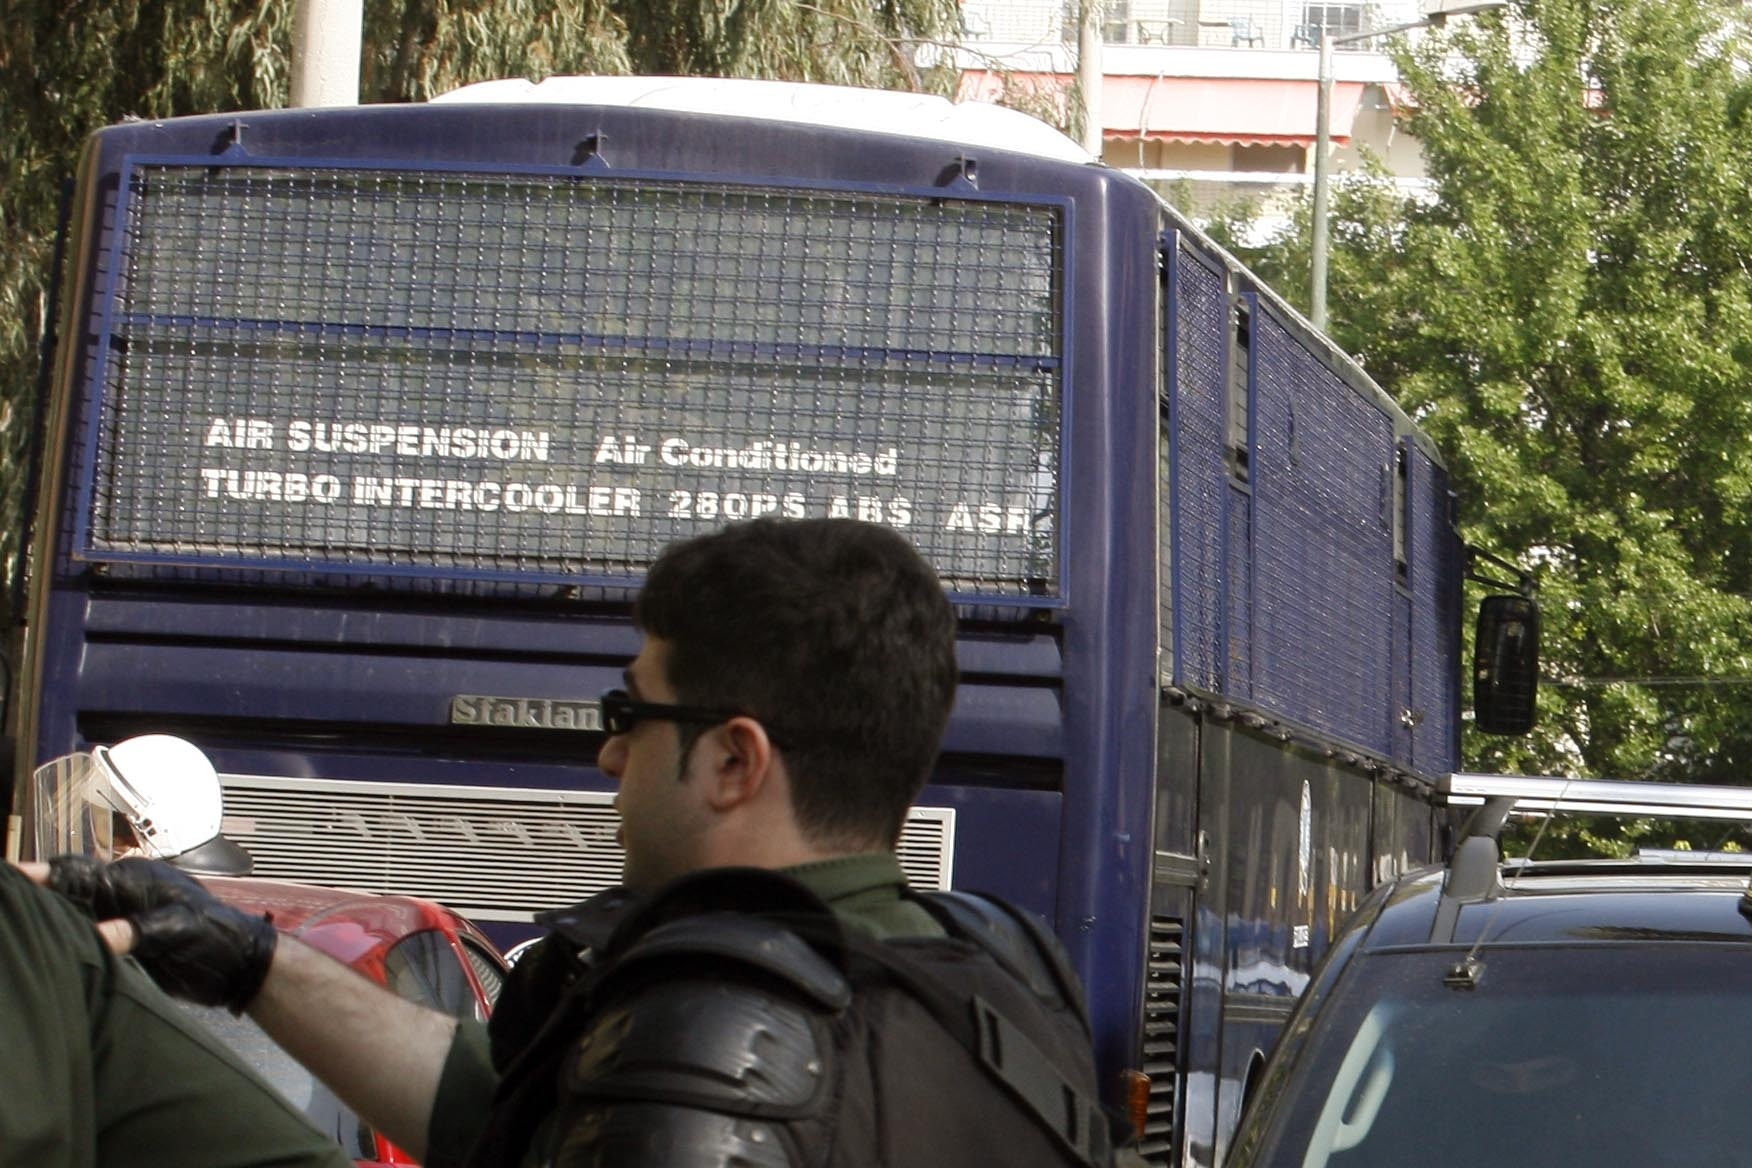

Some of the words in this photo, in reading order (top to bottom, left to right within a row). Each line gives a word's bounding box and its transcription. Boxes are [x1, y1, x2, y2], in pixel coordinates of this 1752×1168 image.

[205, 418, 273, 450] AIR
[287, 421, 550, 461] SUSPENSION
[595, 434, 650, 464] Air
[660, 437, 899, 476] Conditioned
[201, 468, 342, 504] TURBO
[353, 476, 641, 517] INTERCOOLER
[668, 489, 806, 520] 280PS
[827, 495, 913, 528] ABS
